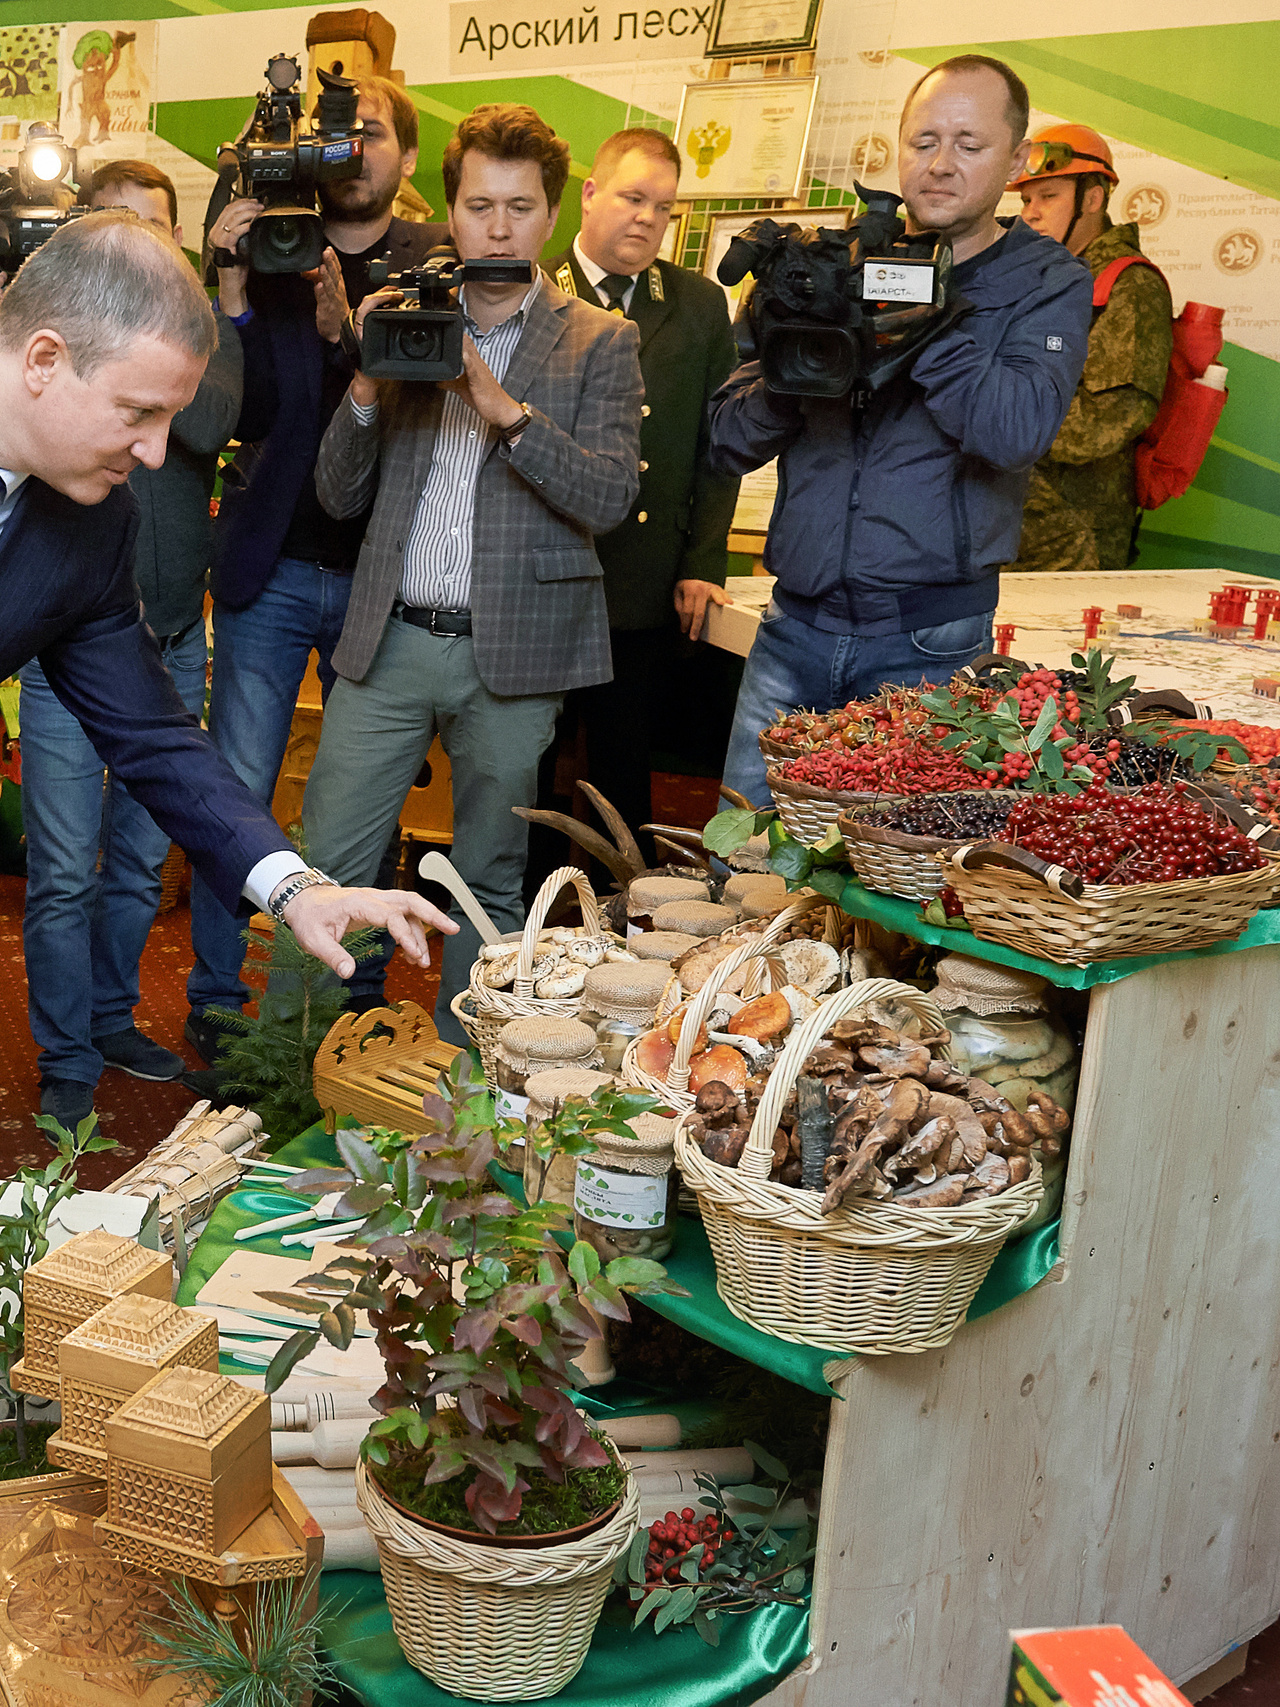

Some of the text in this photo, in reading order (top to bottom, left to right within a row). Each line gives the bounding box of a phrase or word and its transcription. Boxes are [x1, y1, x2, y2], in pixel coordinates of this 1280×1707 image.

[459, 6, 599, 60] Арский
[614, 5, 711, 41] лесх
[324, 141, 359, 154] РОССИЯ 1
